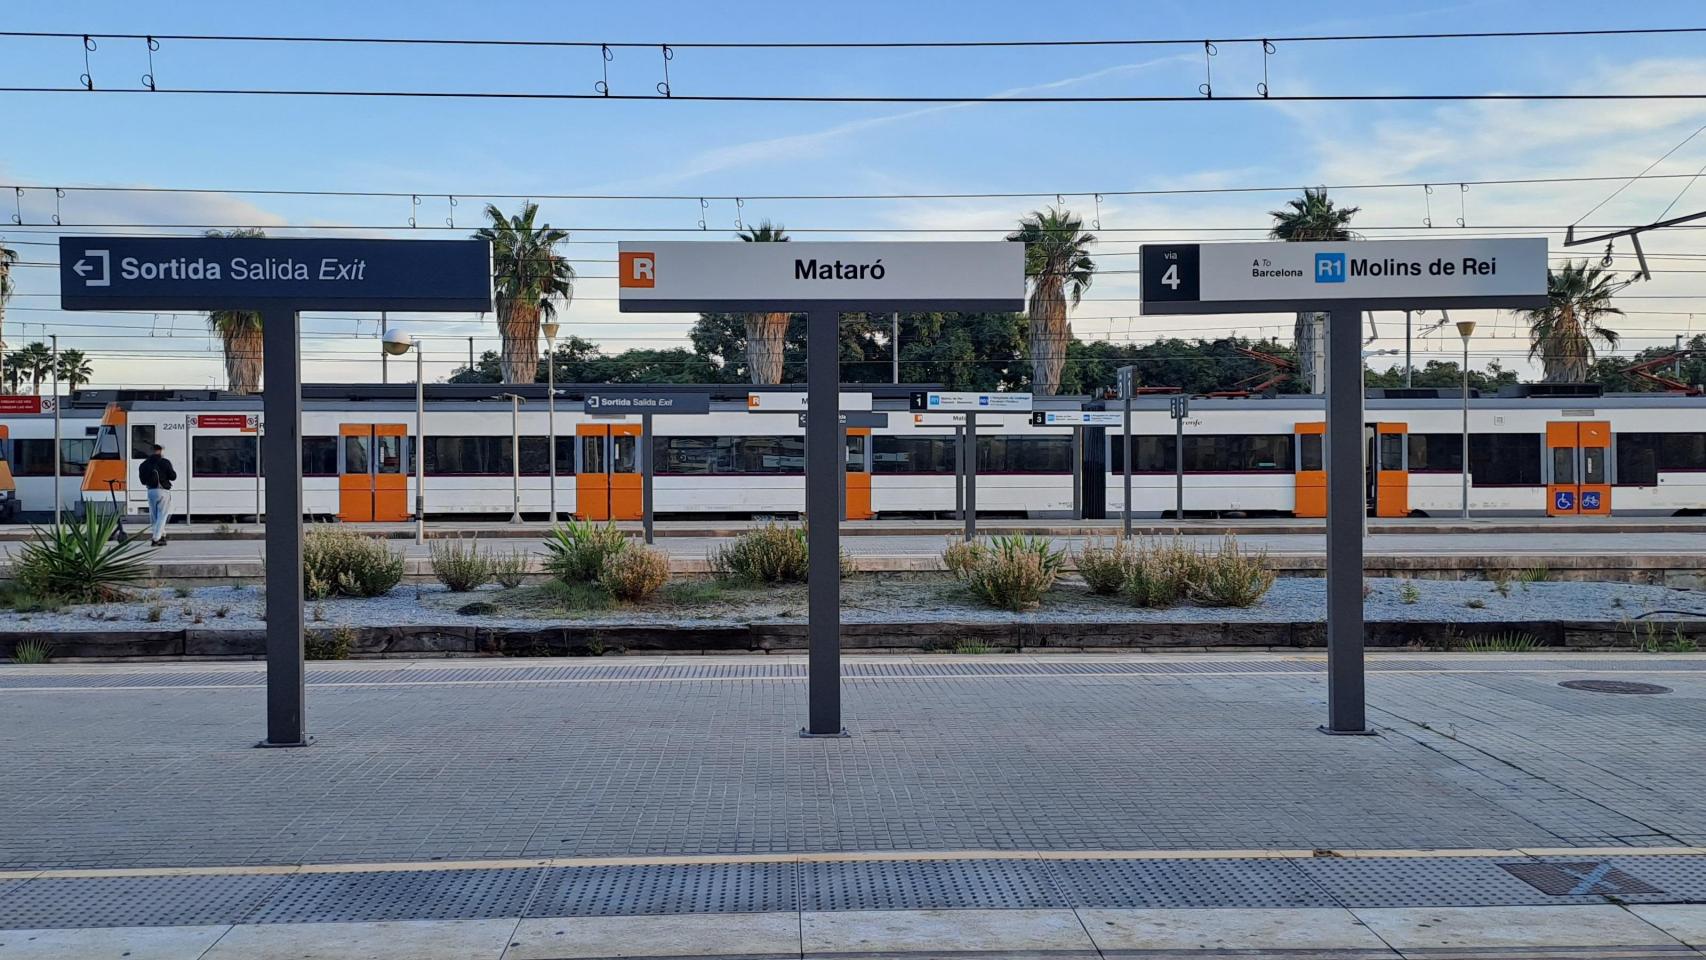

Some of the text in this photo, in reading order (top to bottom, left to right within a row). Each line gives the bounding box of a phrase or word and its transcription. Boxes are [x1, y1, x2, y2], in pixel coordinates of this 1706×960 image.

[1164, 251, 1178, 260] via
[1253, 259, 1272, 267] A To
[121, 256, 367, 280] Sortida Salida Exit
[633, 257, 654, 280] R
[794, 258, 886, 280] Mataró
[1252, 268, 1303, 277] Barcelona
[1318, 259, 1342, 276] R1
[1350, 257, 1497, 276] Molins de Rei
[1161, 264, 1181, 290] 4
[1118, 382, 1123, 398] 3
[601, 398, 673, 406] Sortida Salida Exit
[752, 397, 760, 405] R
[916, 397, 921, 407] 1
